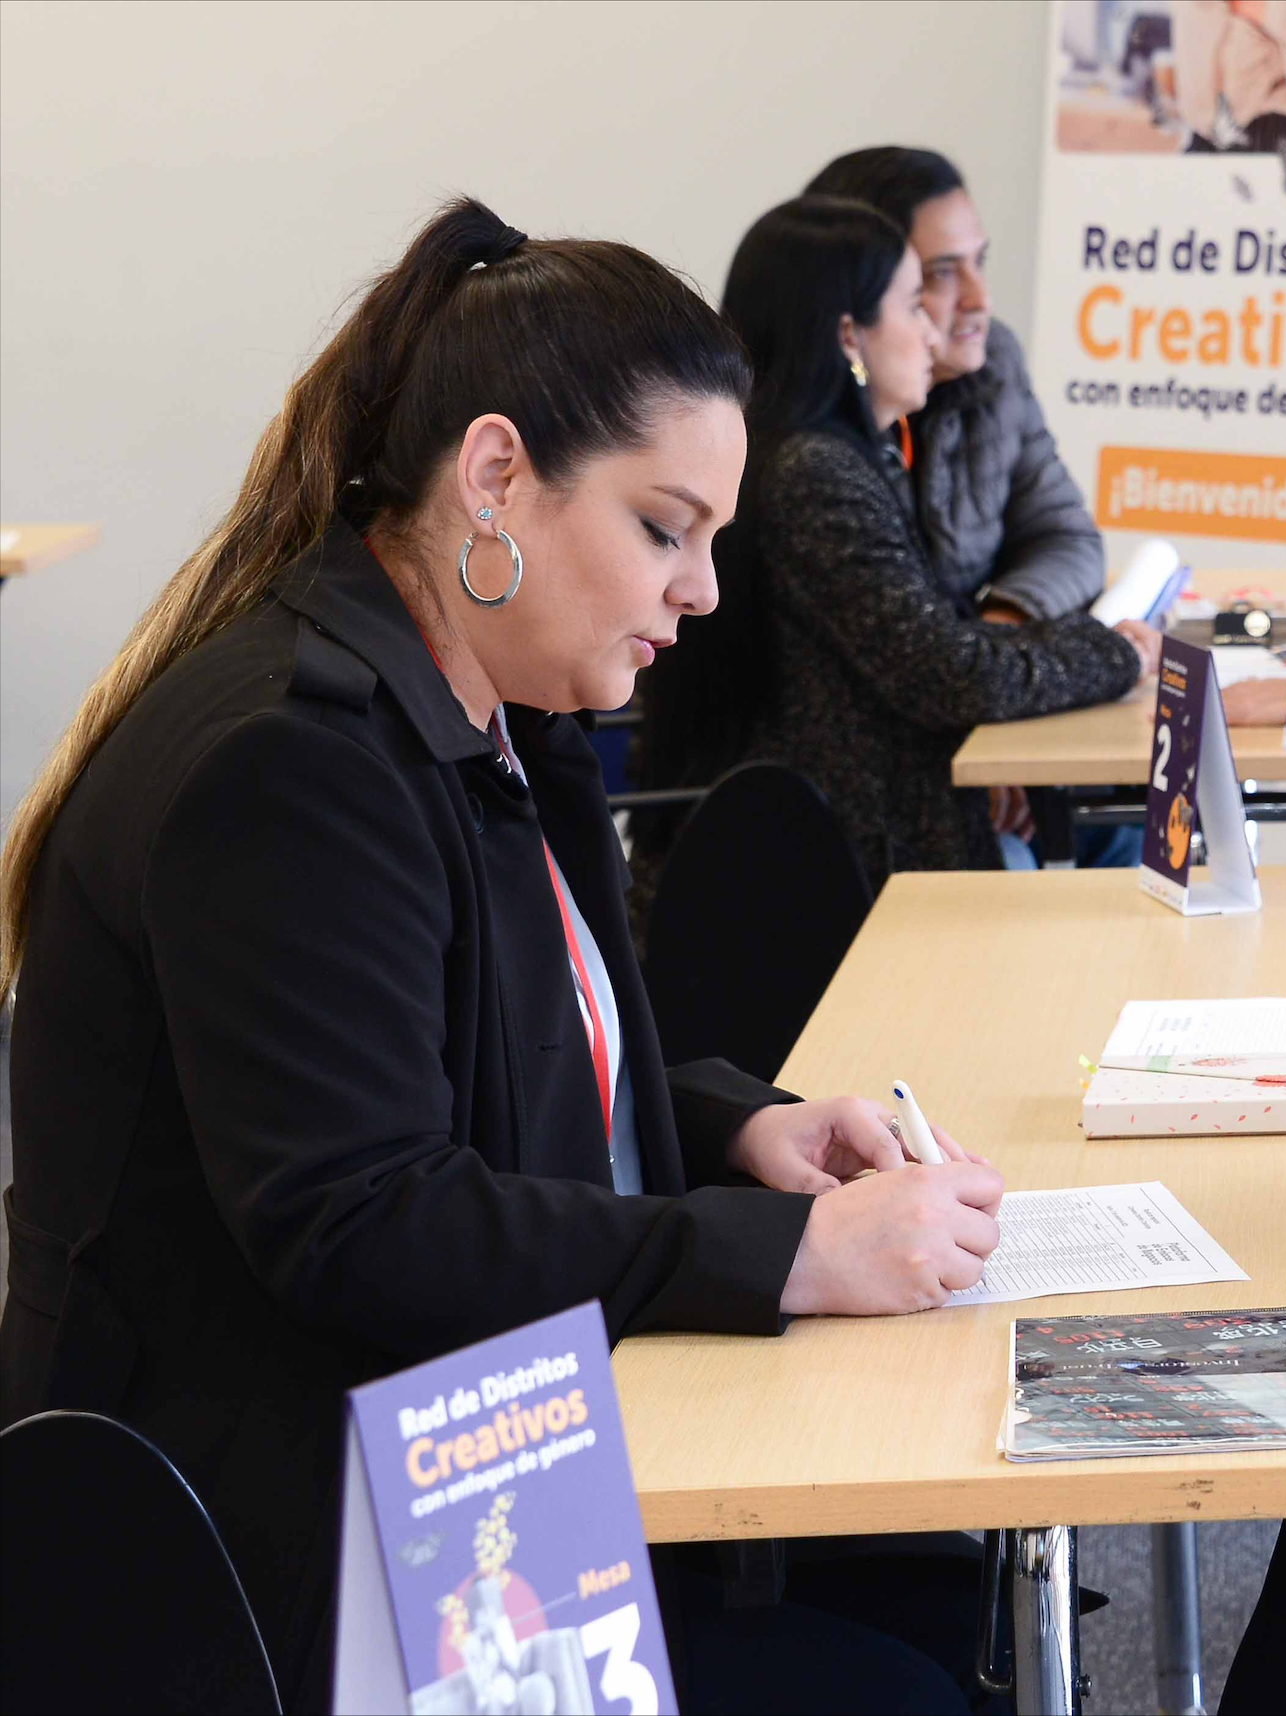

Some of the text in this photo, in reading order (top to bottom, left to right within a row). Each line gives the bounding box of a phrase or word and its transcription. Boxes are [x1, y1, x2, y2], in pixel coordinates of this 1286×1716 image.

[1084, 226, 1158, 270] Red
[1172, 229, 1219, 273] de
[1066, 379, 1119, 405] con
[1129, 377, 1248, 420] enfoque
[1153, 724, 1171, 792] 2
[398, 1352, 578, 1440] Red de Distritos
[406, 1389, 588, 1487] Creativos
[410, 1429, 597, 1518] con enfoque de género
[578, 1560, 631, 1599] Mesa
[579, 1602, 659, 1716] 3
